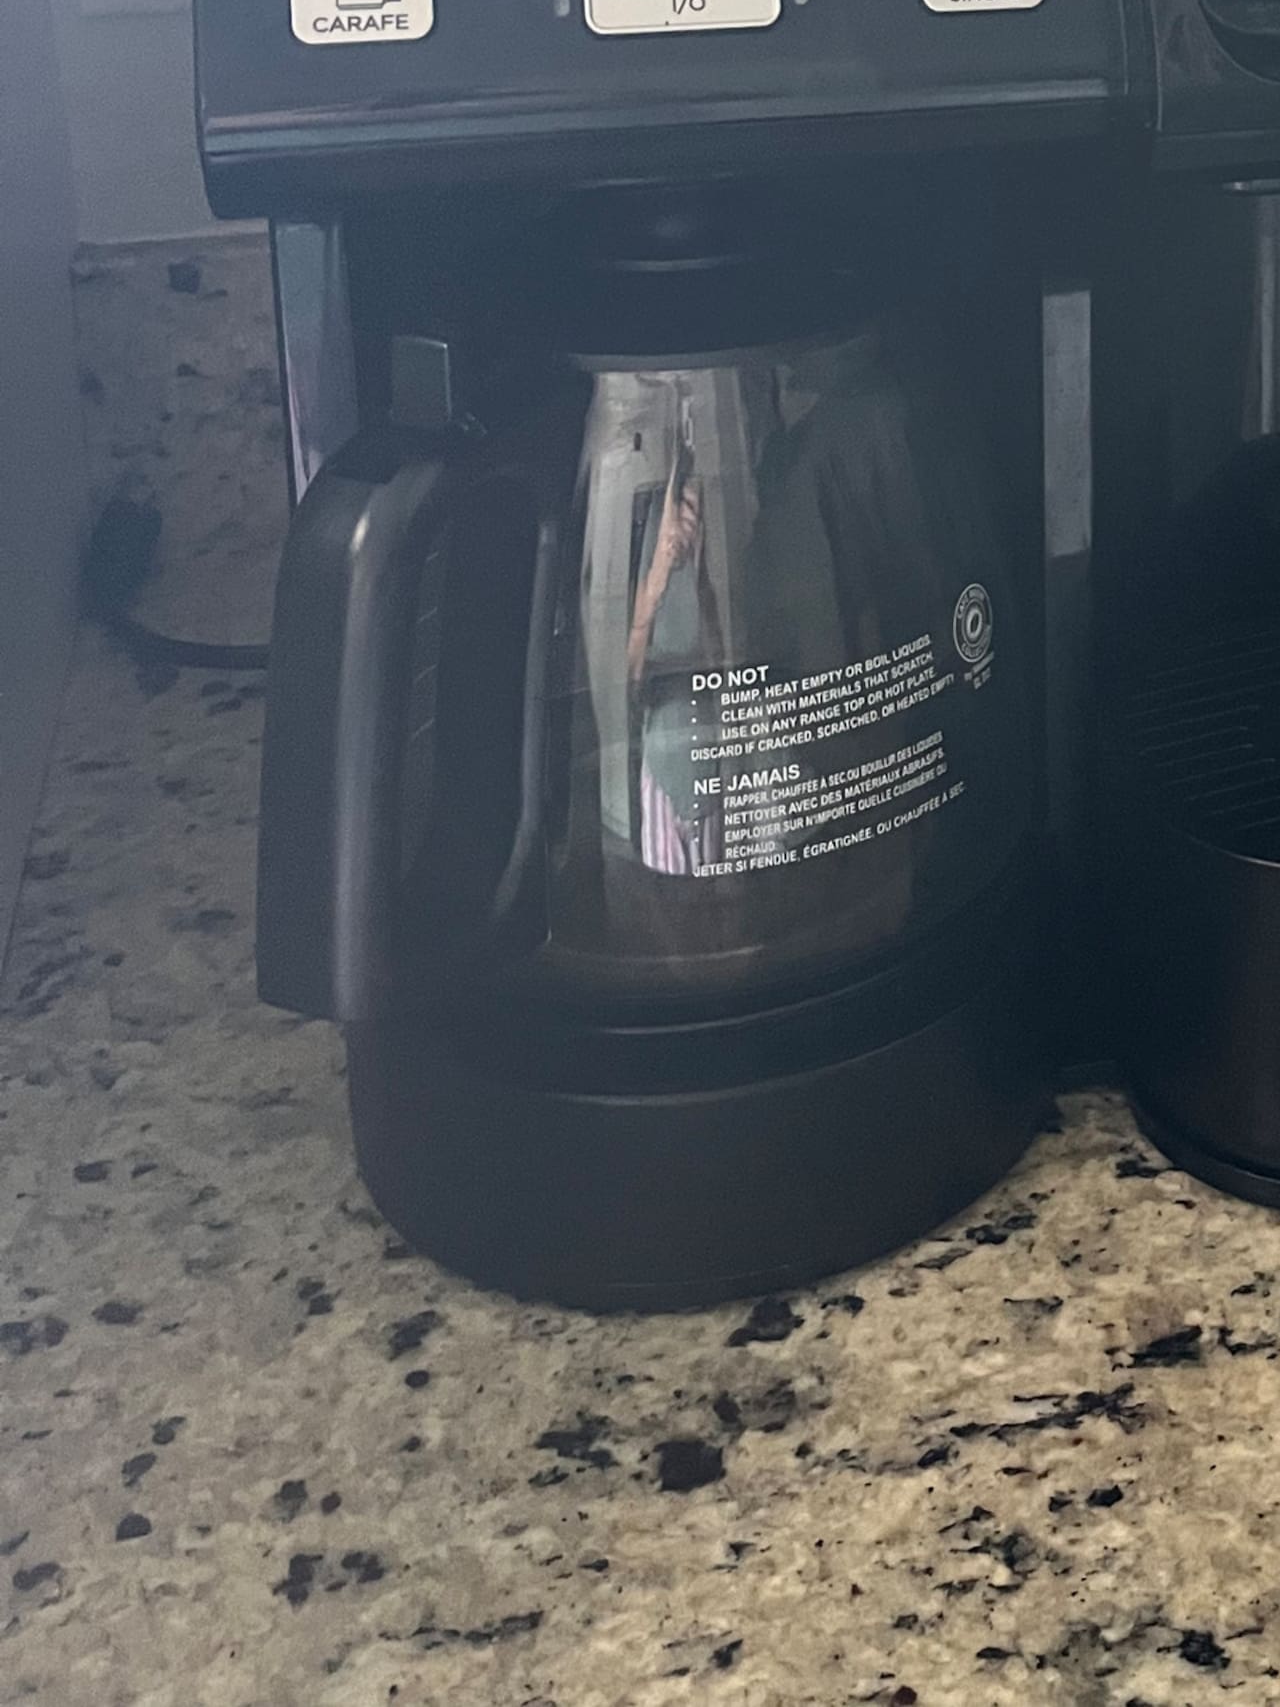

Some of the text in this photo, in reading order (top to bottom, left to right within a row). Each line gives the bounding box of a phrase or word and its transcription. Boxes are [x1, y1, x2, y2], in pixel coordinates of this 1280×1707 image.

[312, 14, 409, 33] CARAFE
[692, 665, 769, 692] DO NOT
[721, 705, 763, 724] CLEAN
[765, 699, 797, 716] WITH
[799, 680, 862, 709] MATERIALS
[863, 670, 890, 689] THAT
[764, 680, 799, 699] HEAT
[801, 668, 843, 691] EMPTY
[845, 663, 863, 678] OR
[865, 654, 892, 672] BOIL
[691, 744, 743, 762] DISCARD
[744, 740, 756, 755] IF
[881, 702, 896, 718] OR
[896, 687, 930, 712] HEATED
[930, 672, 955, 696] EMPTY
[721, 725, 748, 741] USE
[750, 721, 770, 736] ON
[771, 715, 798, 733] ANY
[800, 704, 841, 726] RANGE
[843, 697, 866, 714] TOP
[867, 690, 884, 706] OR
[884, 681, 906, 699] HOT
[694, 764, 802, 795] NE JAMAIS
[724, 805, 787, 826] NETTOYER
[788, 796, 818, 815] AVEC
[820, 789, 843, 807] DES
[844, 768, 901, 799] MATÉRIAUX
[828, 771, 846, 788] SEC
[846, 767, 860, 781] OU
[725, 823, 781, 843] EMPLOYER
[783, 816, 805, 834] SUR
[857, 788, 893, 812] QUELLE
[692, 861, 734, 878] JETER
[735, 860, 748, 873] SI
[876, 819, 892, 835] OU
